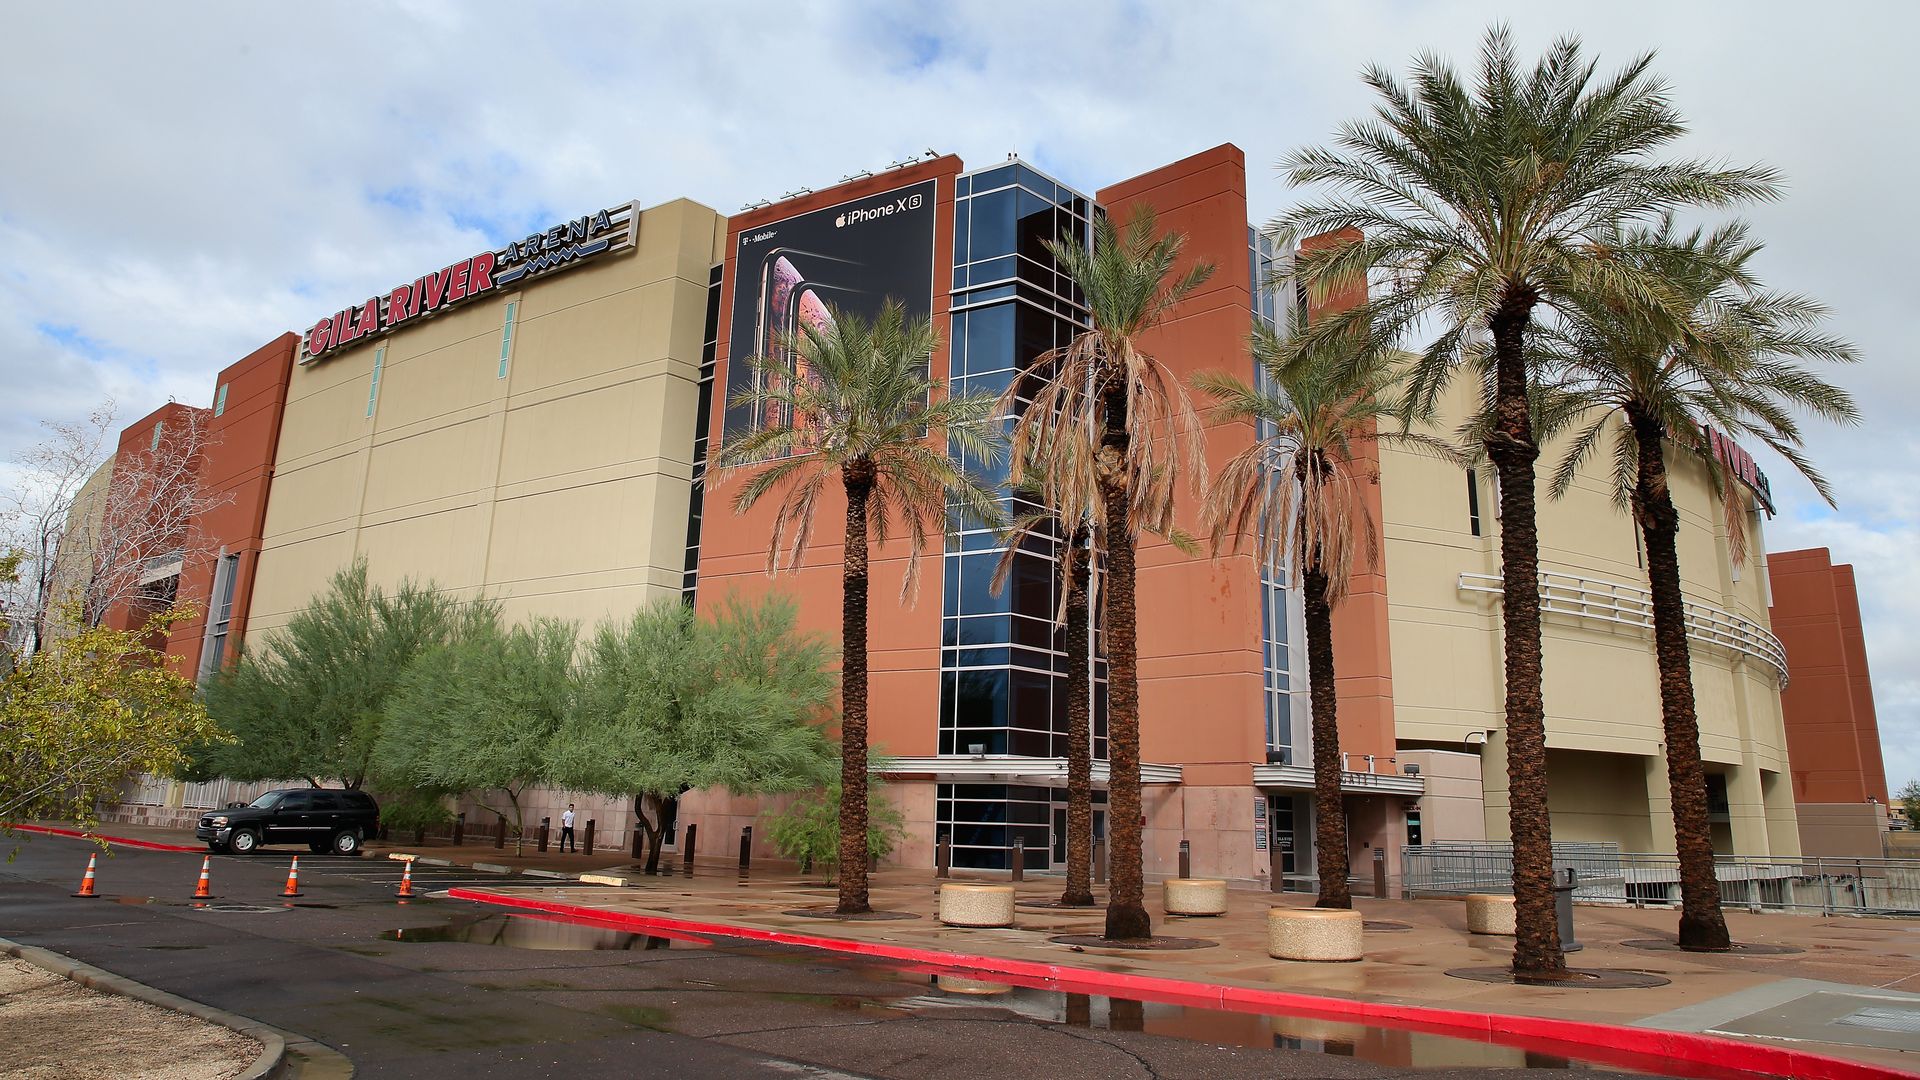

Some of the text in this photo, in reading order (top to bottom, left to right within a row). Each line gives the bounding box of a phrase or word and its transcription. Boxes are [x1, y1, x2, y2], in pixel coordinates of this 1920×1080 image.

[847, 204, 895, 226] iPhone
[309, 208, 612, 356] GILA RIVER ARENA
